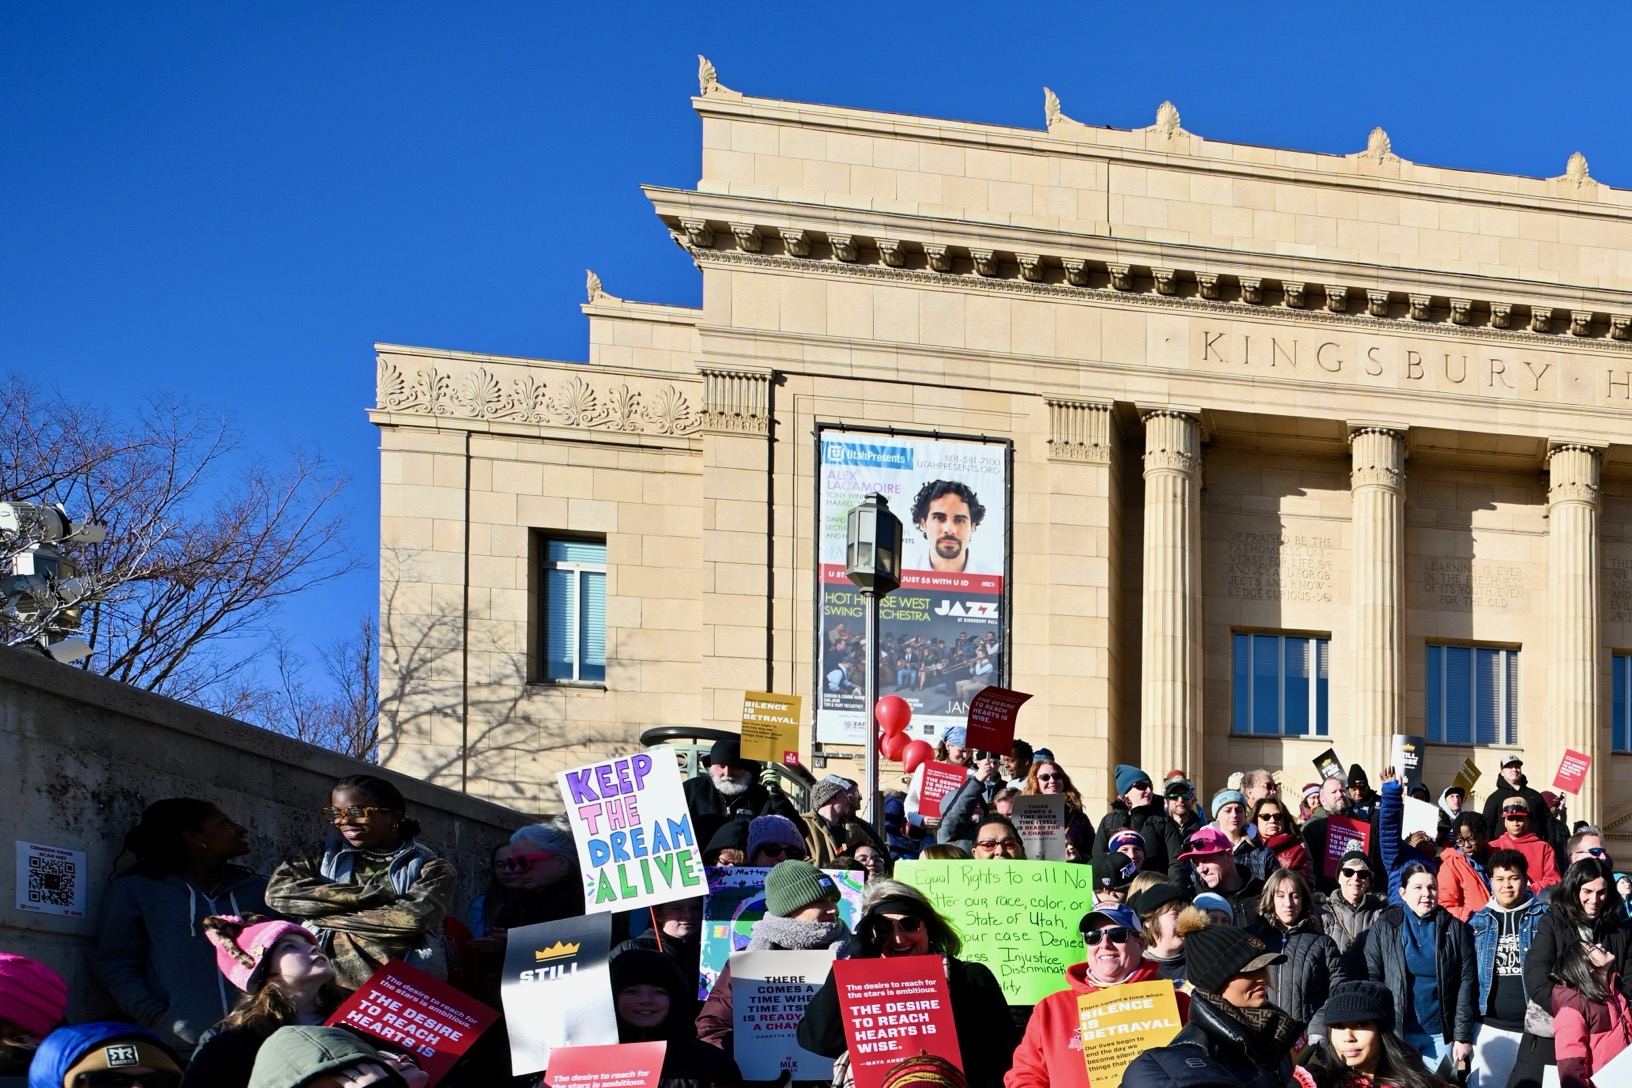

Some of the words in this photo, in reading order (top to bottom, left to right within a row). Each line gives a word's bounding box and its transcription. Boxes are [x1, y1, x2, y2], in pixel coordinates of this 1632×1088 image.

[1201, 330, 1553, 392] KINGSBURY
[847, 450, 905, 464] UtahPresents
[945, 454, 1000, 466] 801-581-7100
[916, 460, 1000, 474] UTAHPRESENTS.ORG
[827, 470, 857, 481] ALEX
[827, 480, 901, 493] LACAMOIRE
[902, 576, 920, 584] JUST
[921, 576, 931, 585] $5
[932, 577, 952, 586] WITH
[961, 579, 969, 587] ID
[825, 592, 851, 604] HOT
[901, 597, 931, 610] WEST
[824, 606, 863, 616] SWING
[934, 600, 998, 619] JAZZ
[745, 701, 788, 711] SILENCE
[743, 714, 799, 725] BETRAYAL.
[565, 754, 653, 804] KEEP
[578, 795, 641, 836] THE
[587, 813, 693, 868] DREAM
[595, 850, 700, 904] ALIVE
[915, 865, 950, 894] Equal
[961, 865, 1001, 891] Rights
[1005, 866, 1023, 884] to
[1064, 869, 1087, 889] No
[1070, 901, 1084, 910] or
[966, 911, 1003, 926] State
[1040, 931, 1084, 949] Denied
[846, 983, 861, 992] The
[863, 982, 888, 990] desire
[901, 980, 924, 988] reach
[925, 979, 937, 987] for
[847, 990, 862, 999] the
[863, 990, 886, 998] stars
[887, 988, 894, 996] is
[895, 987, 938, 996] ambitious.
[850, 1004, 882, 1016] THE
[885, 1000, 940, 1013] DESIRE
[853, 1017, 874, 1028] TO
[878, 1012, 929, 1025] REACH
[855, 1027, 917, 1041] HEARTS
[922, 1024, 936, 1035] IS
[857, 1041, 903, 1054] WISE.
